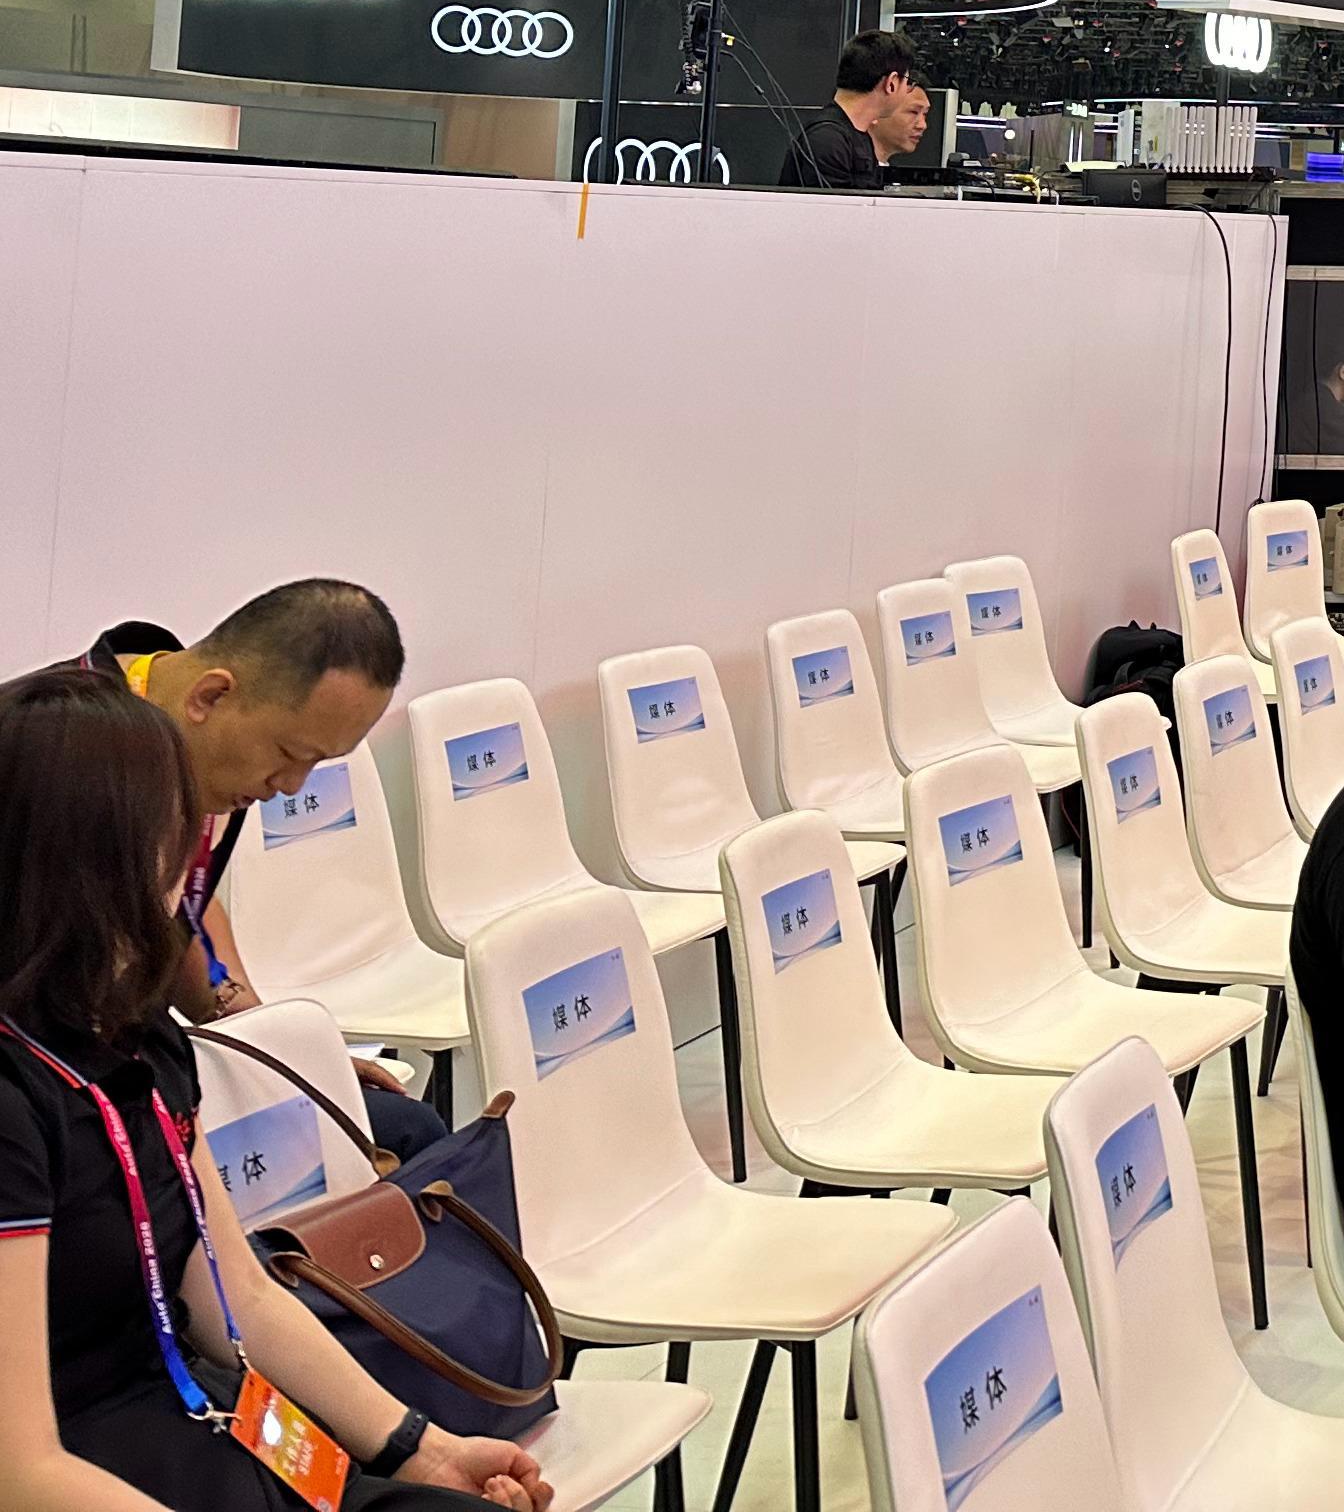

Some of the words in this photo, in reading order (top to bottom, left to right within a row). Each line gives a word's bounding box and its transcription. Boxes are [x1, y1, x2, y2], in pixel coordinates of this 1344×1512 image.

[649, 700, 676, 719] 媒体
[467, 750, 496, 772] 媒体
[283, 793, 319, 818] 媒体
[960, 826, 990, 854] 媒体
[781, 905, 809, 936] 媒体
[552, 993, 592, 1031] 媒体
[1110, 1162, 1136, 1209] 媒体
[138, 1221, 156, 1257] 2026
[152, 1298, 174, 1334] Auto
[960, 1365, 1007, 1434] 媒体
